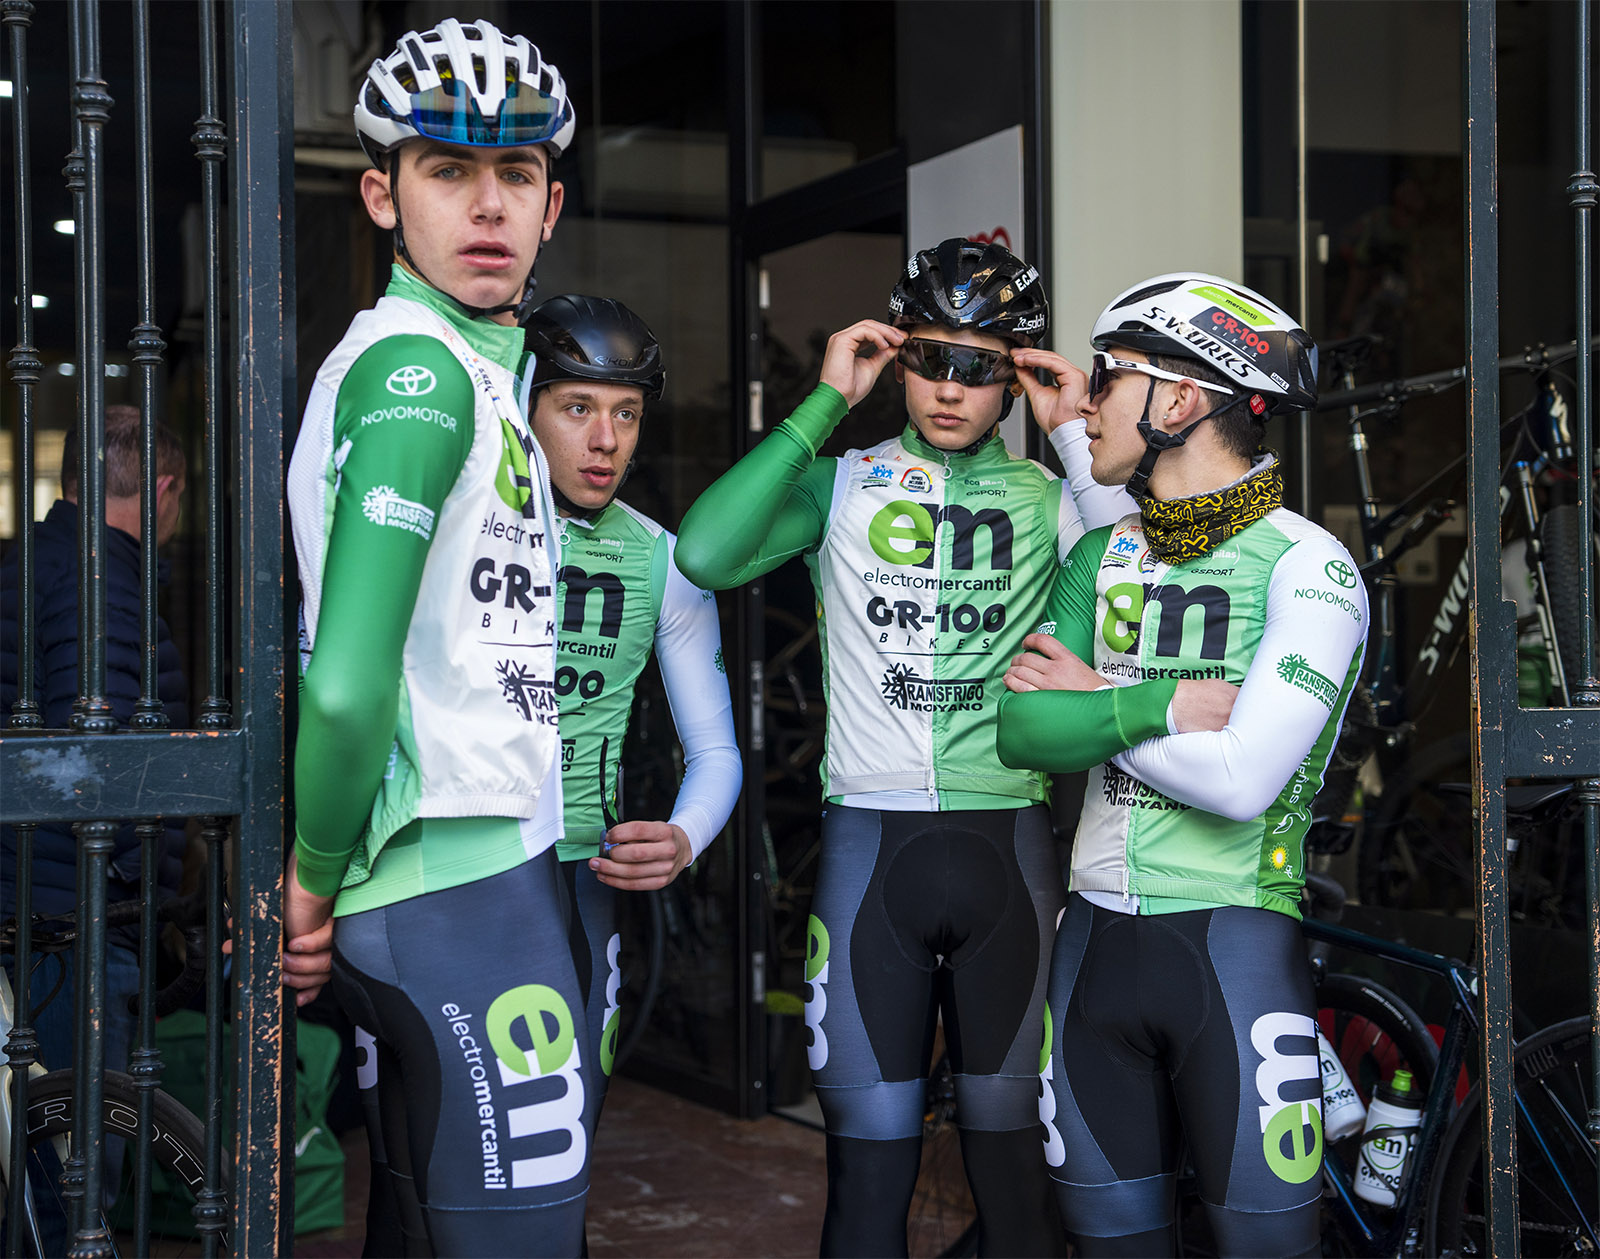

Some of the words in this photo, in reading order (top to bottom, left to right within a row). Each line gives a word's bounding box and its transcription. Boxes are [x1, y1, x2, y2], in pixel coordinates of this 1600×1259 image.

[1142, 306, 1257, 378] S-WORKS
[1211, 311, 1270, 355] GR-100
[1211, 325, 1259, 359] BIKES
[361, 406, 457, 433] NOVOMOTOR
[868, 499, 1013, 571] em
[863, 567, 1012, 592] electromercantil
[866, 596, 1006, 633] GR-100
[1102, 582, 1231, 661] em
[1294, 588, 1362, 626] NOVOMOTOR
[879, 632, 990, 650] BIKES
[910, 701, 984, 712] MOYANO
[441, 1002, 507, 1190] electromercantil
[485, 983, 588, 1189] em
[1250, 1011, 1324, 1185] em
